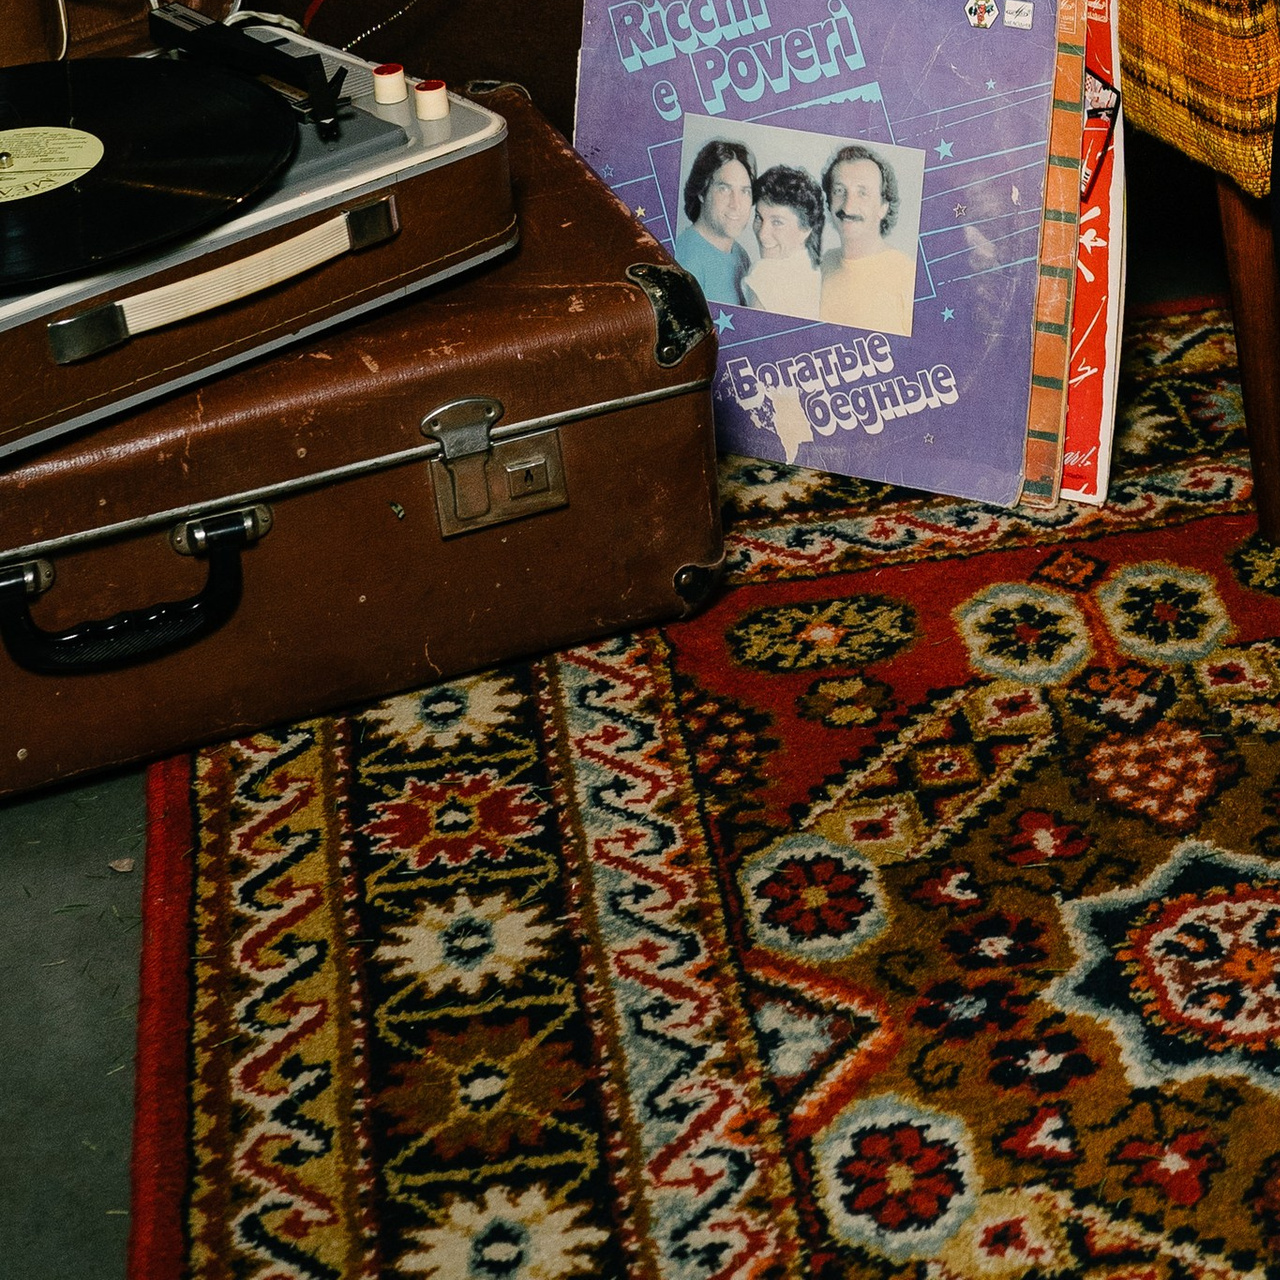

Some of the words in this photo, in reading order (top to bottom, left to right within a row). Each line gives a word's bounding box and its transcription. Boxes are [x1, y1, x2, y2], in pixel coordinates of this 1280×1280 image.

[653, 80, 682, 121] e
[726, 332, 894, 410] Богатые
[804, 364, 959, 436] бедные
